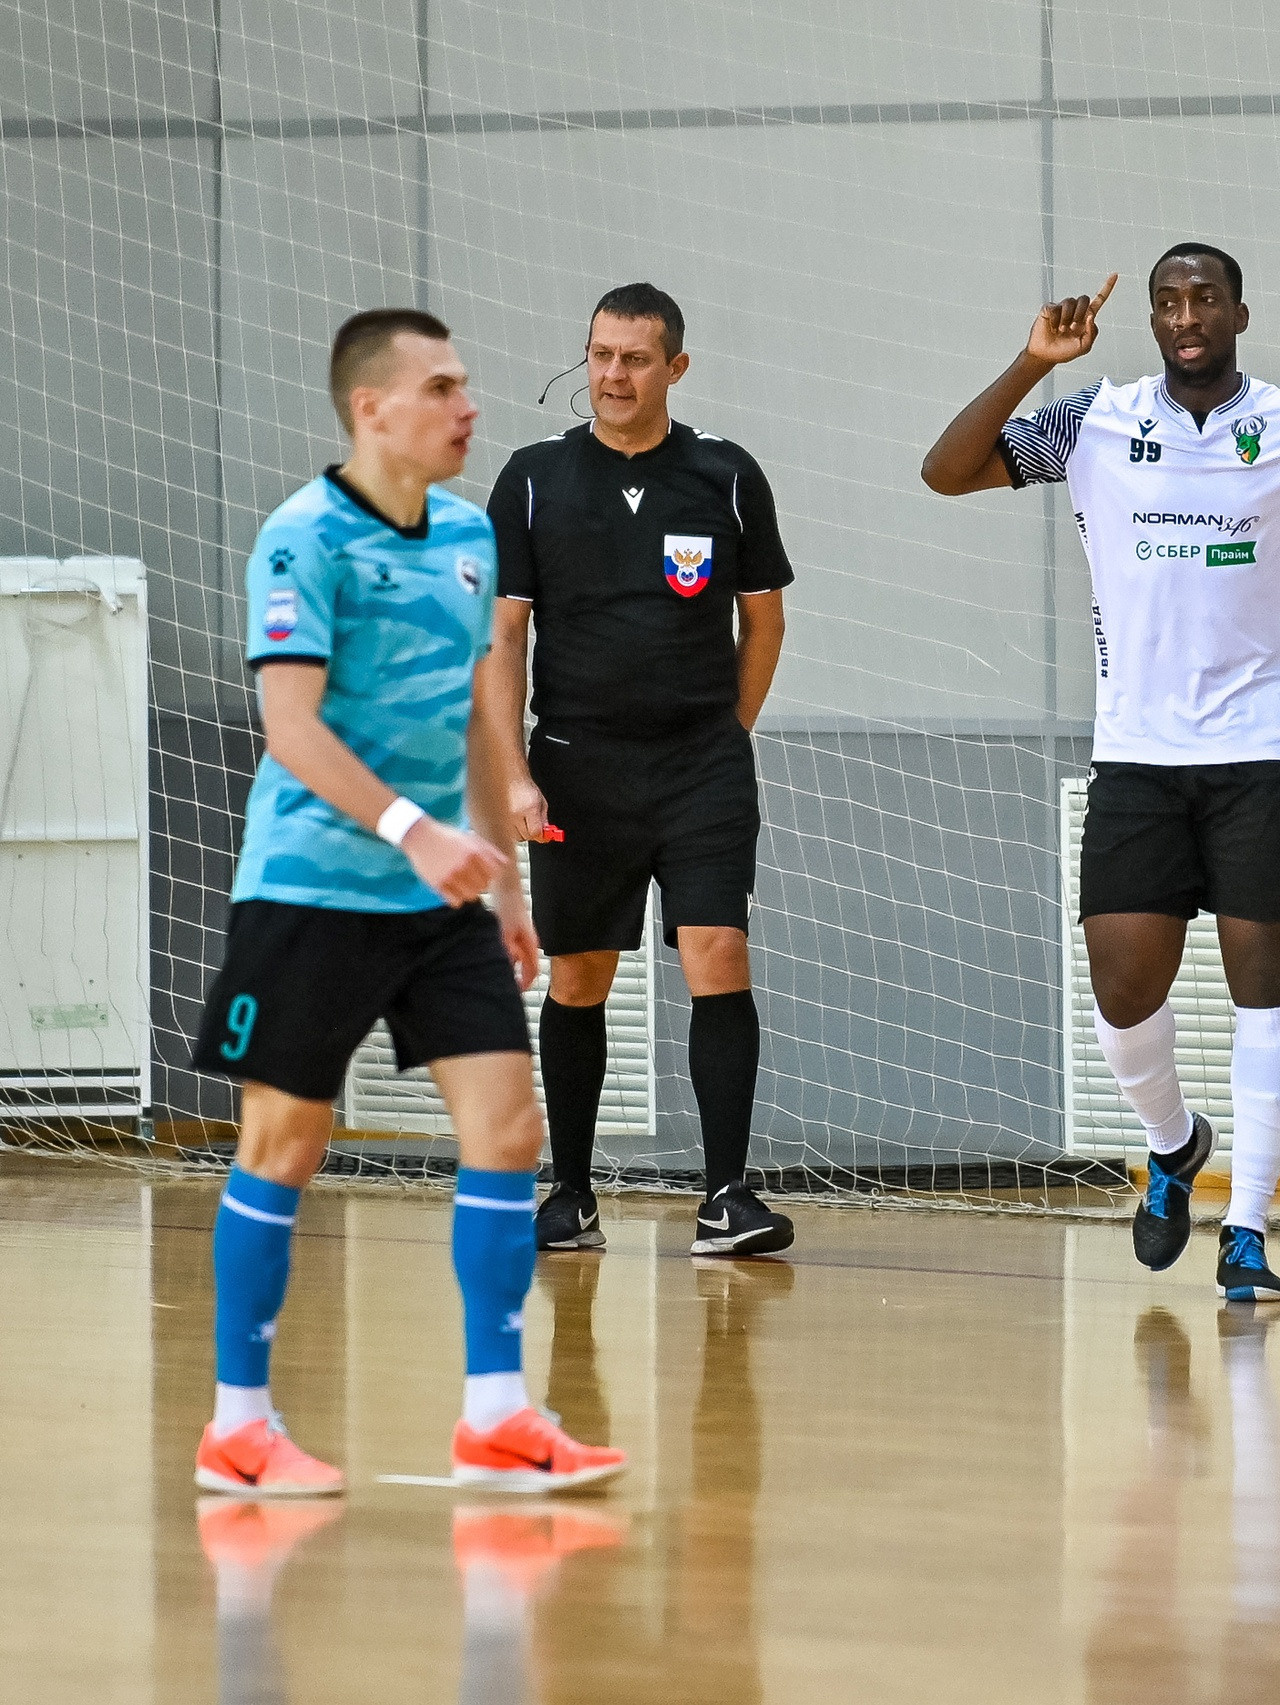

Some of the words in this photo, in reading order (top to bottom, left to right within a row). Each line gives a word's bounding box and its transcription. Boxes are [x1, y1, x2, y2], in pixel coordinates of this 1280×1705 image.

[1129, 438, 1162, 463] 99
[1132, 512, 1223, 526] NORMAN
[1156, 544, 1201, 558] СБЕР
[1211, 548, 1249, 562] Прайм
[220, 994, 258, 1060] 9
